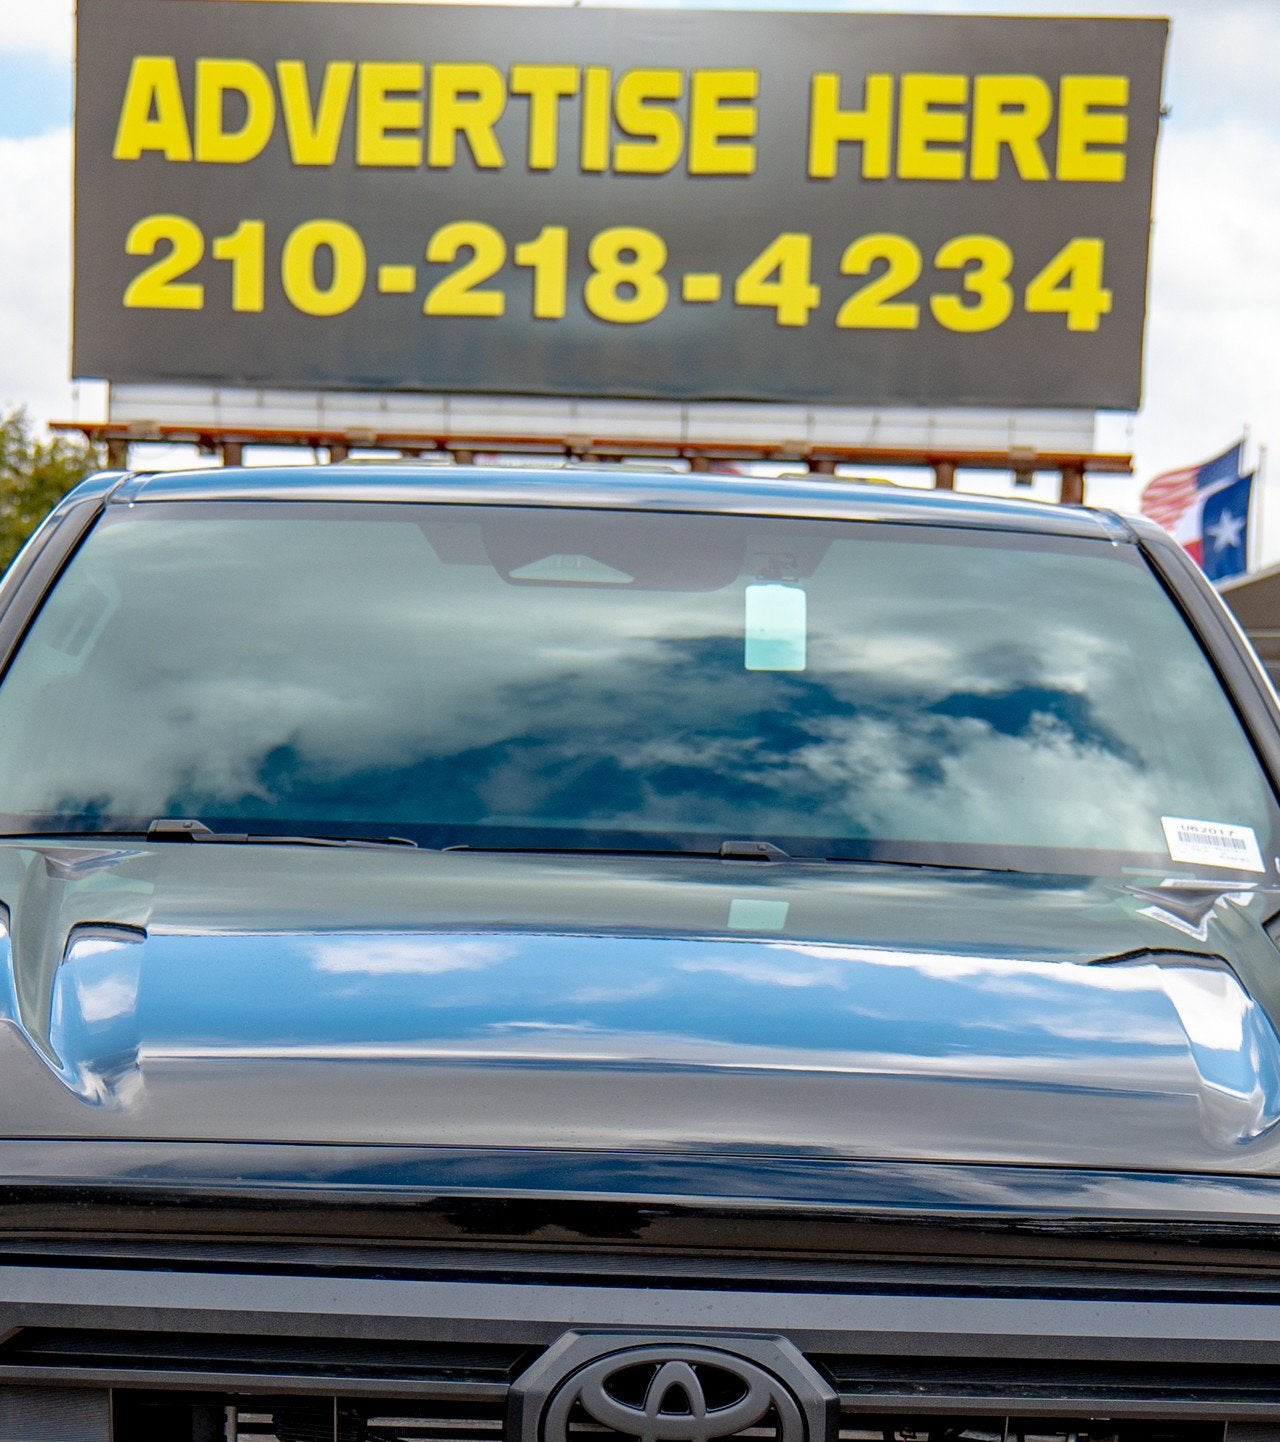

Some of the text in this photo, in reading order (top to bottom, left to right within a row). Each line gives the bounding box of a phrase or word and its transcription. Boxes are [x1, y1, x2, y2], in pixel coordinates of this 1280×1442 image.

[113, 54, 1129, 183] ADVERTISE HERE
[123, 213, 1112, 335] 210-218-4234
